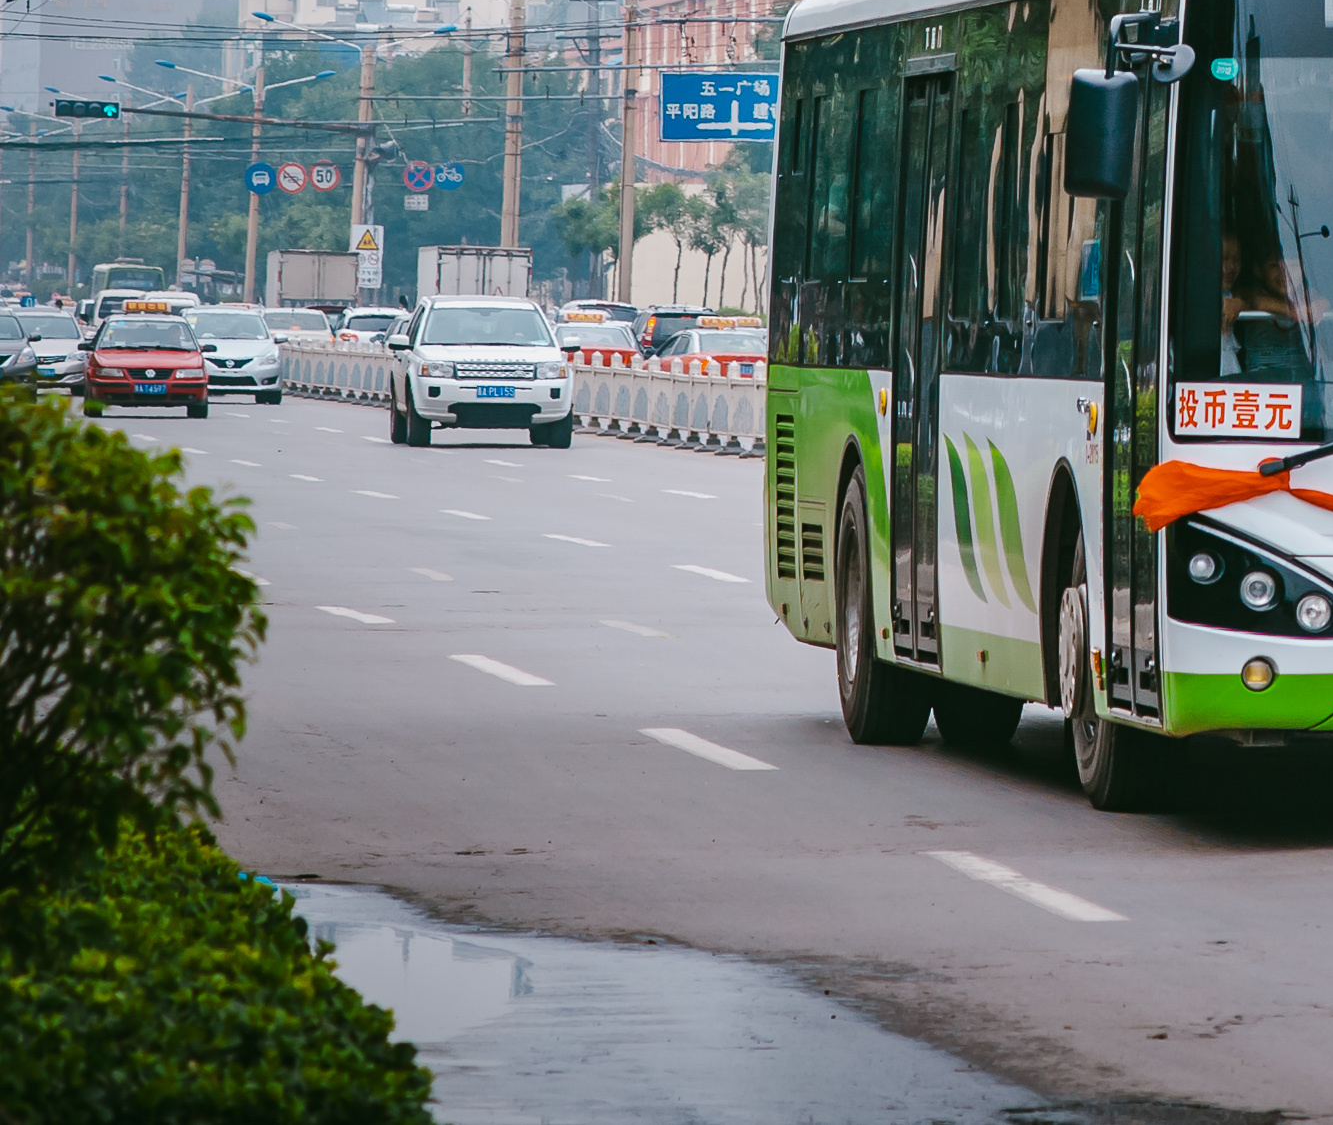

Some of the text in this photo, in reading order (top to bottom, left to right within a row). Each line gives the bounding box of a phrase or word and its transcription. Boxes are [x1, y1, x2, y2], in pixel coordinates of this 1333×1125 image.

[700, 79, 770, 96] 五一广场
[666, 103, 716, 120] 平阳路
[316, 169, 333, 184] 50
[1178, 388, 1293, 431] 投币壹元
